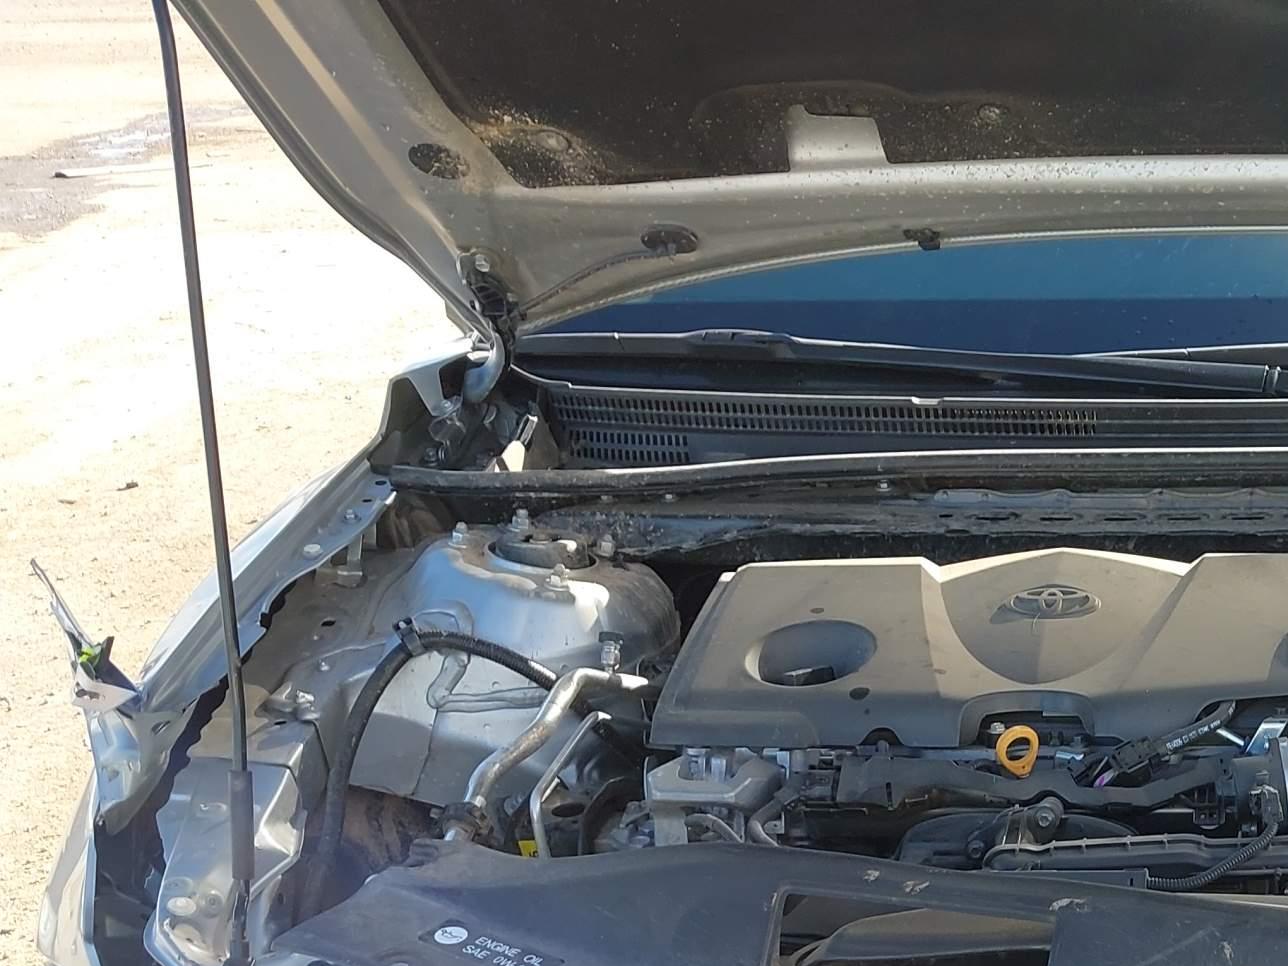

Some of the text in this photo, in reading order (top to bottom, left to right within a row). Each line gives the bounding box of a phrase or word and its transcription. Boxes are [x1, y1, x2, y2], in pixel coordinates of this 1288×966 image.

[462, 945, 491, 959] SAE
[474, 936, 544, 966] ENGINE OIL
